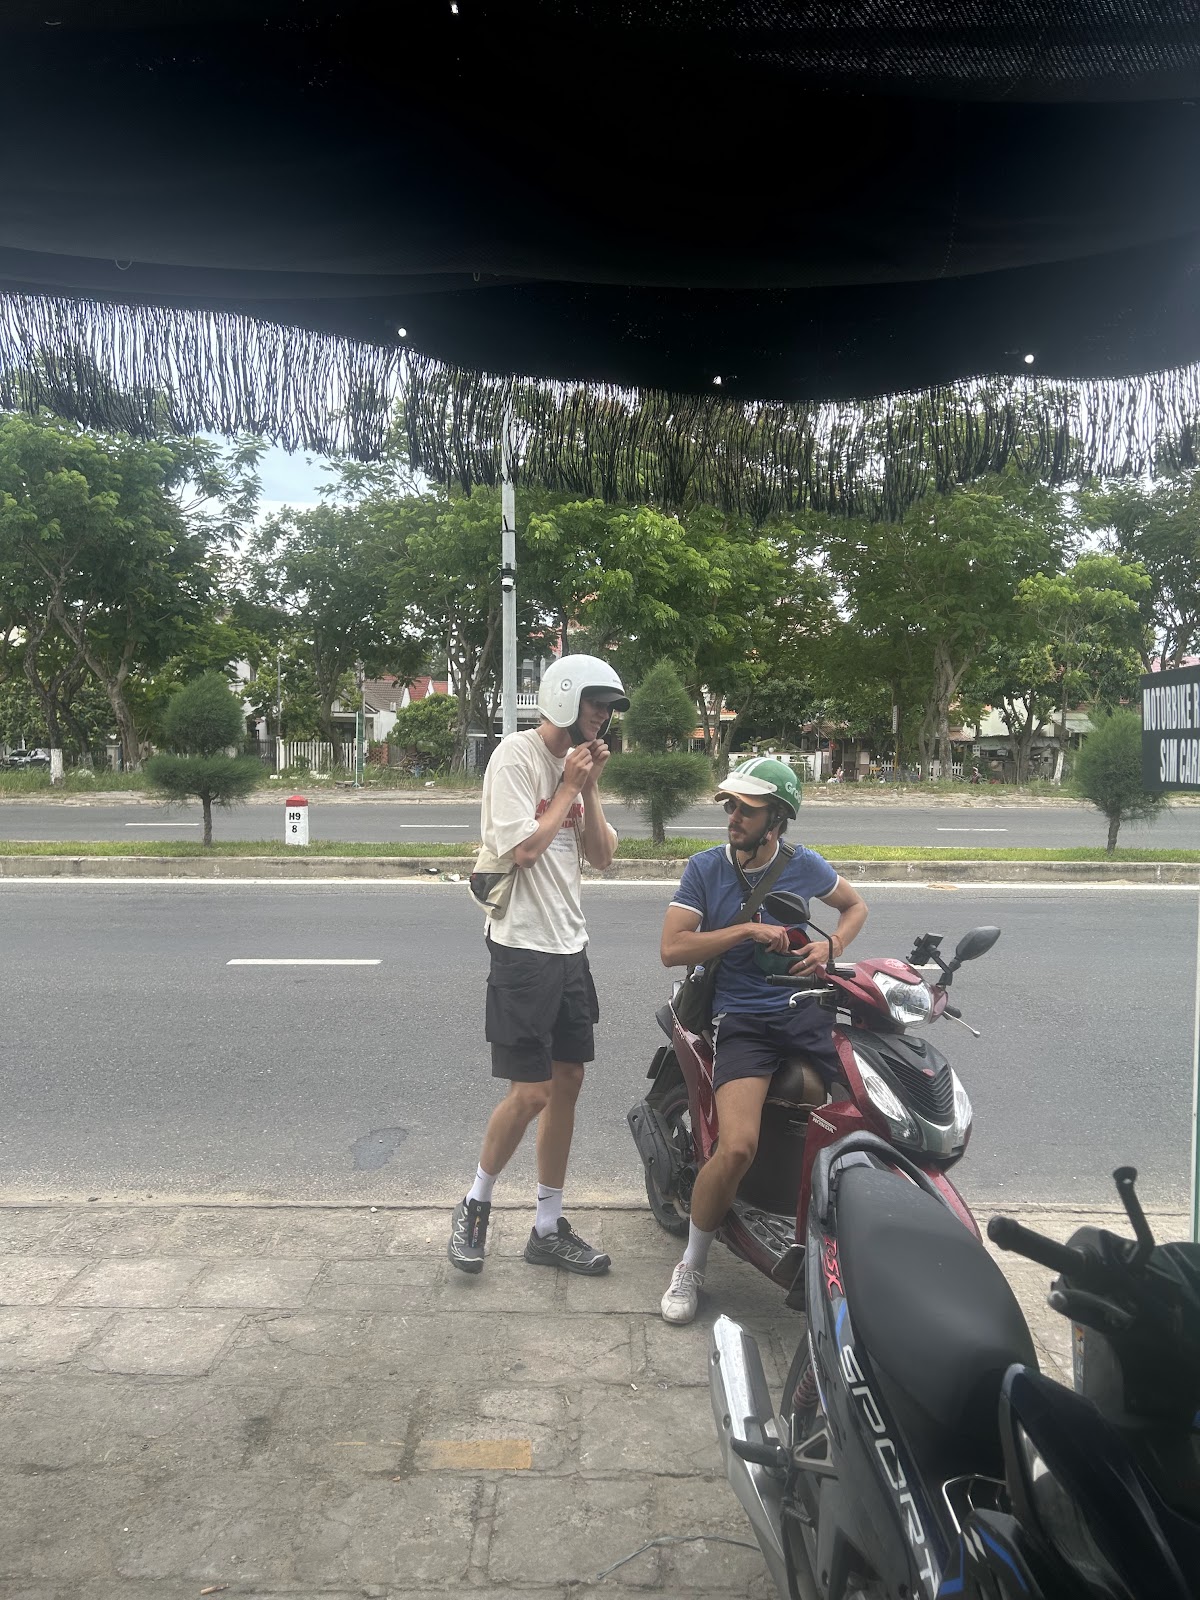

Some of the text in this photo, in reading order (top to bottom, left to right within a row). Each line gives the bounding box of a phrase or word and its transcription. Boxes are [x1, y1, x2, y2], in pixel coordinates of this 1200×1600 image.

[1143, 684, 1191, 731] MOTORBIKE
[1160, 738, 1178, 783] SIM
[288, 812, 301, 821] H9
[291, 824, 298, 833] 8
[812, 1116, 835, 1134] HONDA
[823, 1235, 844, 1299] RSX
[839, 1343, 939, 1600] SPORT
